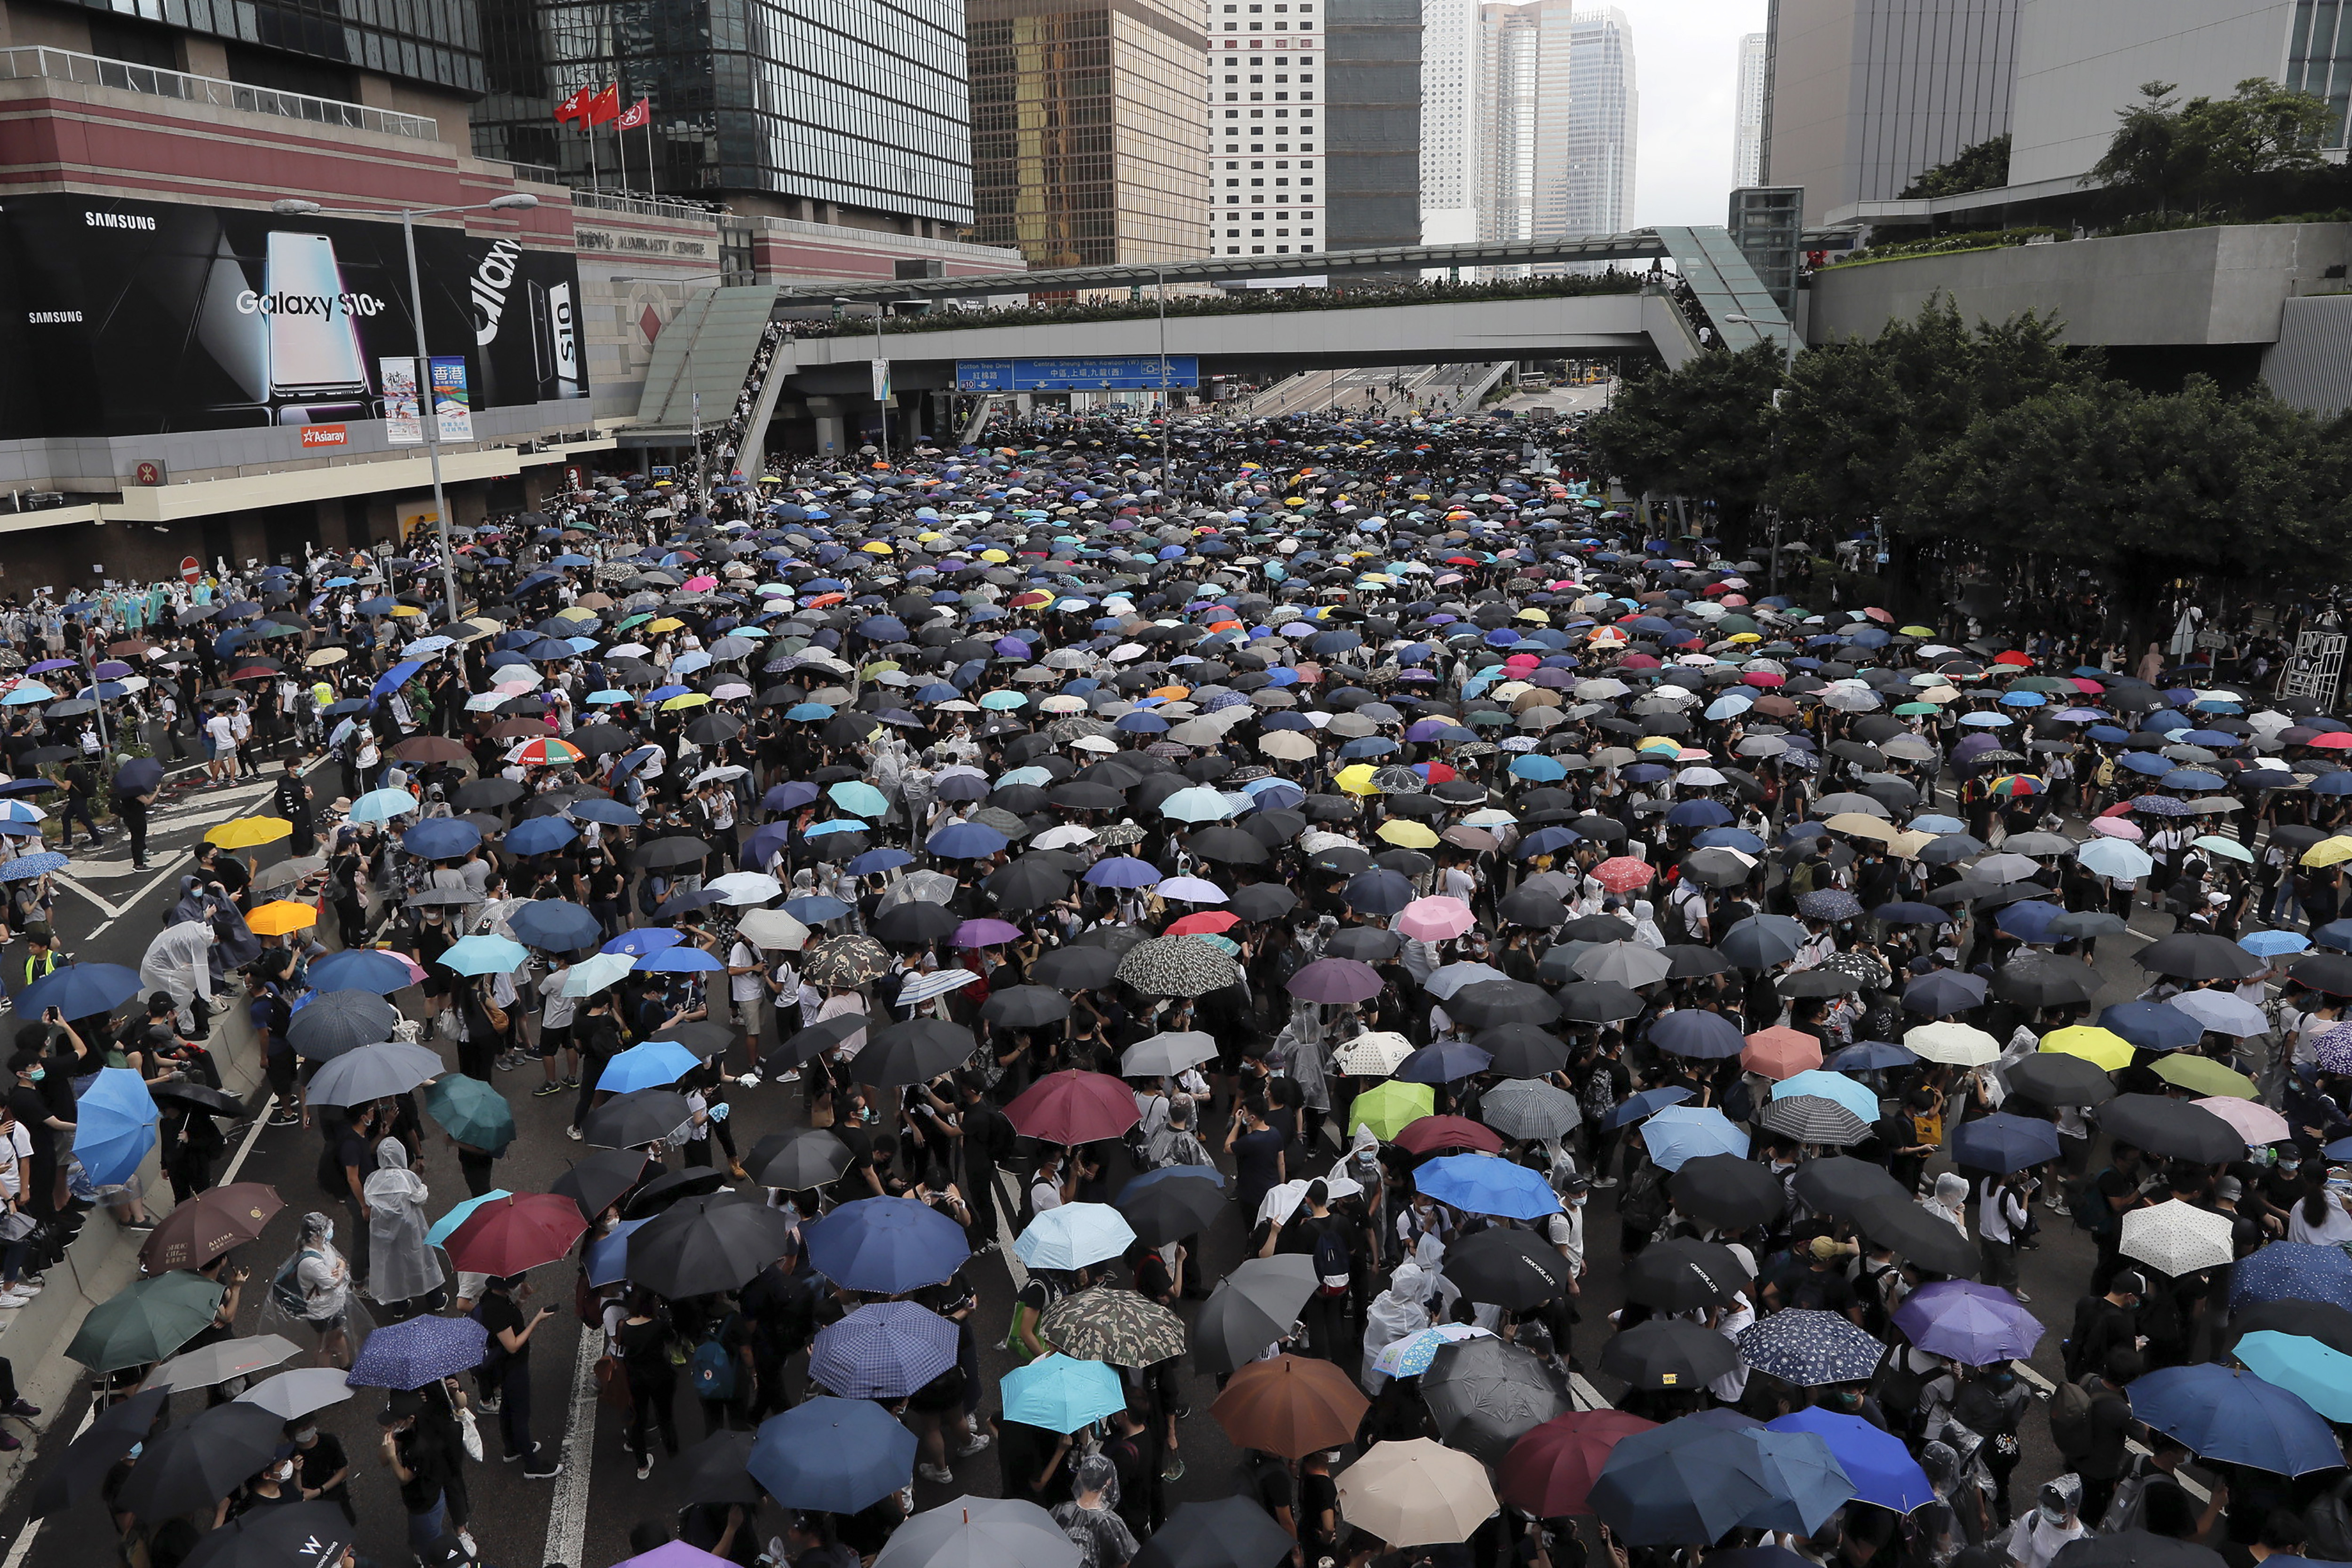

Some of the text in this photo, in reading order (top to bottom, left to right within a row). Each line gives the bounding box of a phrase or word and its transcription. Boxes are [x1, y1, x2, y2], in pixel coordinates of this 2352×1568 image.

[85, 212, 156, 231] SAMSUNG
[236, 289, 385, 322] Galaxy S10+
[29, 311, 82, 323] SAMSUNG
[557, 302, 575, 364] S10
[434, 366, 463, 380] 香港
[315, 430, 345, 443] Asiaray
[299, 1535, 322, 1554] W
[326, 1541, 338, 1556] KONG
